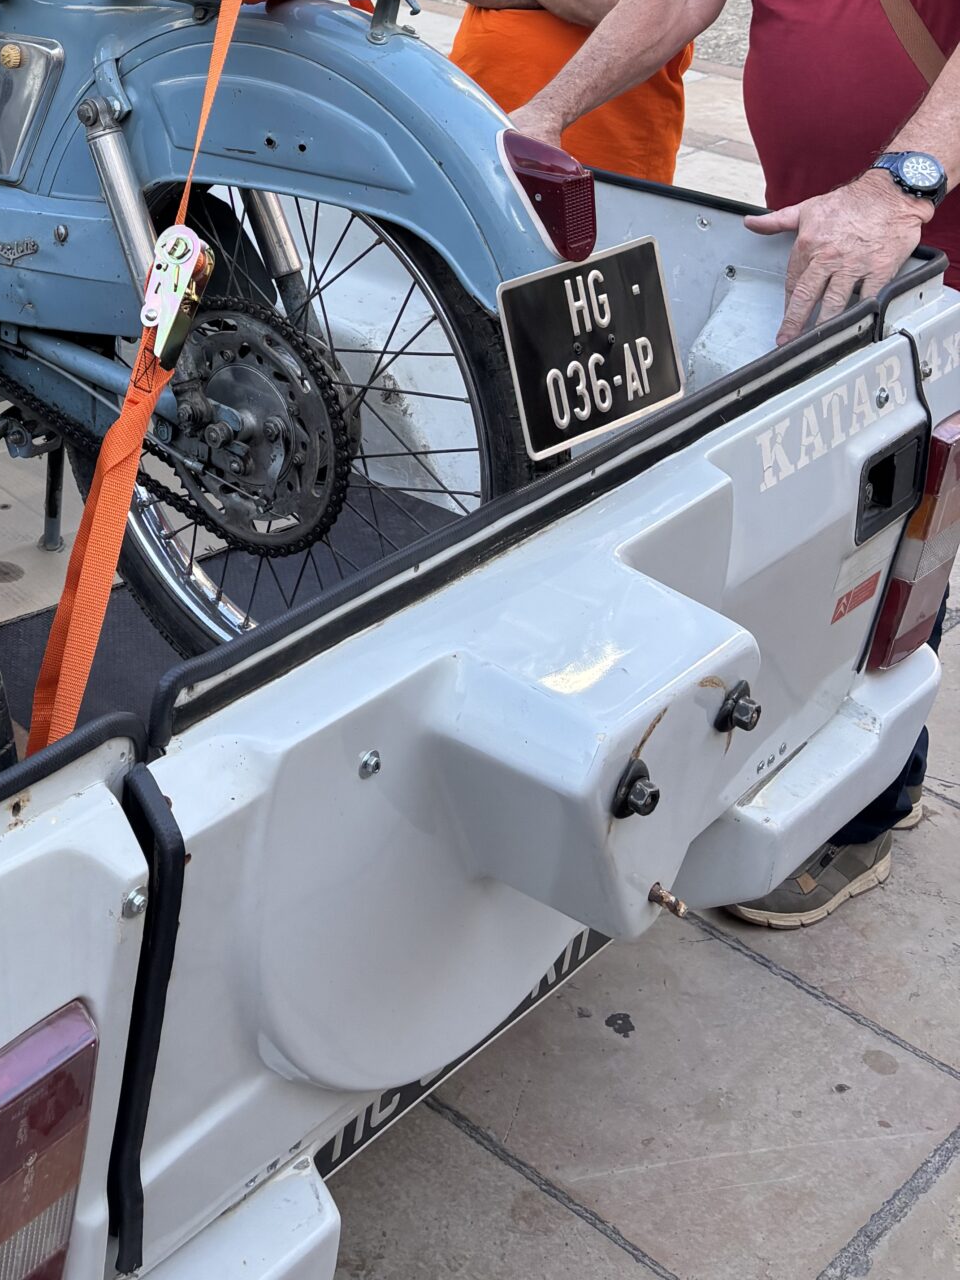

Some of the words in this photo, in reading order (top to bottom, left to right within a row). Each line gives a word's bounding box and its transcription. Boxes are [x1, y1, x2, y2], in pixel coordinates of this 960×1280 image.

[564, 269, 611, 337] HG
[546, 336, 654, 430] 036-AP
[755, 355, 908, 493] KATAR
